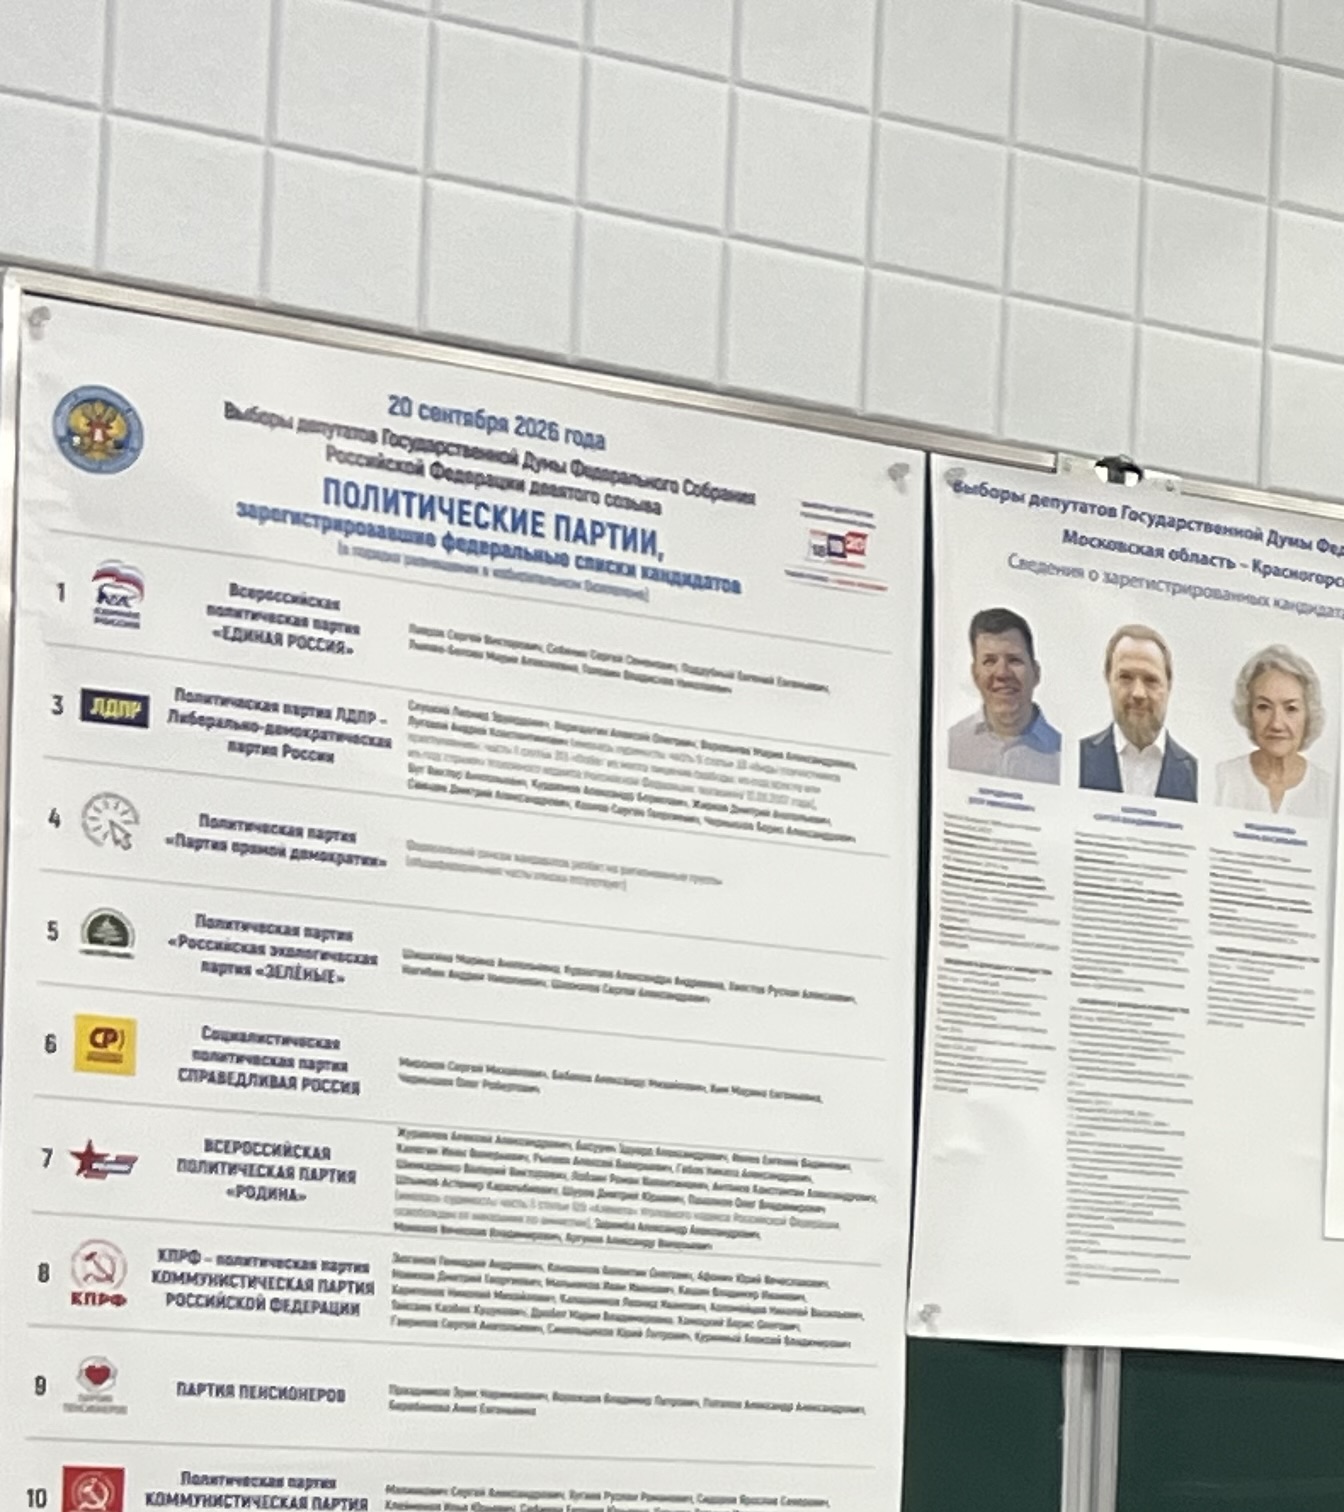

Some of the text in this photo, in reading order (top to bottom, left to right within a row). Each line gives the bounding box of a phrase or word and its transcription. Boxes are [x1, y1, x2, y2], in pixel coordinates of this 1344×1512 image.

[388, 394, 607, 452] 20 сентября 2026 года
[224, 400, 294, 431] Выборы
[522, 450, 568, 475] Думы
[682, 479, 757, 506] Собрания
[325, 444, 426, 478] Российской
[323, 476, 665, 562] ПОЛИТИЧЕСКИЕ ПАРТИИ,
[953, 480, 1026, 504] Выборы
[1029, 492, 1118, 519] депутатов
[1121, 504, 1263, 542] Государственной
[1266, 528, 1314, 552] Думы
[236, 501, 437, 548] зарегистрировавшие
[441, 531, 570, 568] федеральные
[574, 553, 637, 580] списки
[640, 565, 743, 595] кандидатов
[1062, 529, 1164, 559] Московская
[1169, 547, 1236, 571] область
[1008, 552, 1085, 580] Сведения
[1088, 568, 1099, 582] о
[1103, 568, 1270, 608] зарегистрированных
[56, 582, 67, 603] 1
[51, 695, 64, 716] 3
[90, 697, 142, 721] ЛДПР
[174, 687, 280, 714] Политическая
[283, 701, 333, 721] партия
[335, 706, 377, 726] ЛДПР
[227, 739, 335, 764] партия России
[48, 807, 61, 829] 4
[199, 812, 357, 845] Политическая партия
[46, 920, 60, 942] 5
[195, 912, 354, 944] Политическая партия
[200, 960, 252, 978] партия
[44, 1033, 57, 1054] 6
[298, 1056, 349, 1074] партия
[178, 1067, 361, 1096] СПРАВЕДЛИВАЯ РОССИЯ
[41, 1147, 54, 1169] 7
[204, 1138, 332, 1161] ВСЕРОССИЙСКАЯ
[176, 1158, 357, 1184] ПОЛИТИЧЕСКАЯ ПАРТИЯ
[226, 1184, 307, 1203] «РОДИНА»
[37, 1262, 50, 1284] 8
[158, 1248, 201, 1266] КПРФ
[216, 1252, 317, 1272] политическая
[320, 1259, 371, 1276] партия
[151, 1269, 376, 1297] КОММУНИСТИЧЕСКАЯ ПАРТИЯ
[71, 1291, 127, 1308] КПРФ
[166, 1291, 361, 1317] РОССИЙСКОЙ ФЕДЕРАЦИИ
[34, 1375, 47, 1396] 9
[176, 1381, 346, 1403] ПАРТИЯ ПЕНСИОНЕРОВ
[180, 1470, 337, 1491] Политическая партия
[26, 1488, 48, 1509] 10
[145, 1492, 369, 1512] КОММУНИСТИЧЕСКАЯ ПАРТИЯ
